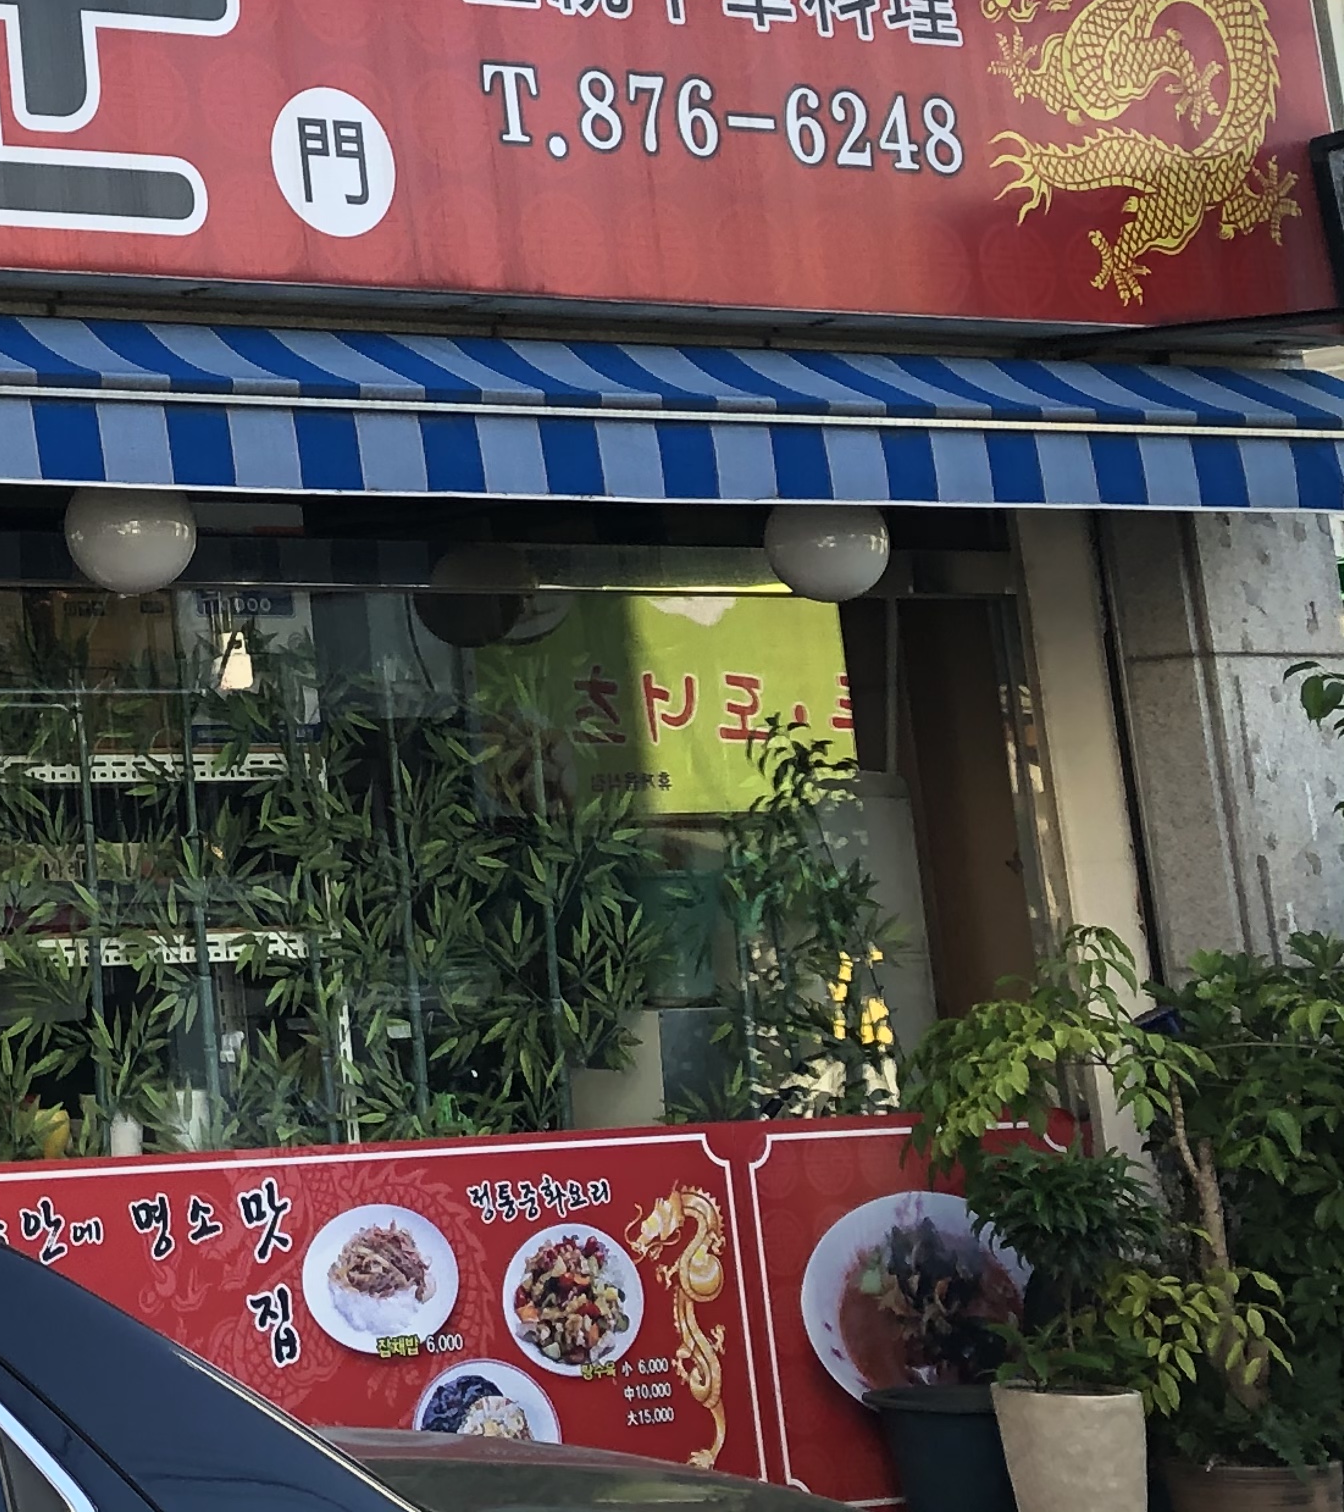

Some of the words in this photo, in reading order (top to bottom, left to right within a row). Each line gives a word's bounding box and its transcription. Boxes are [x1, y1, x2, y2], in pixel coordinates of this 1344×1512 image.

[480, 61, 965, 178] T.876-6248
[466, 1173, 611, 1224] 정통중화요리
[377, 1334, 420, 1358] 잡채밥
[426, 1333, 464, 1354] 6,000
